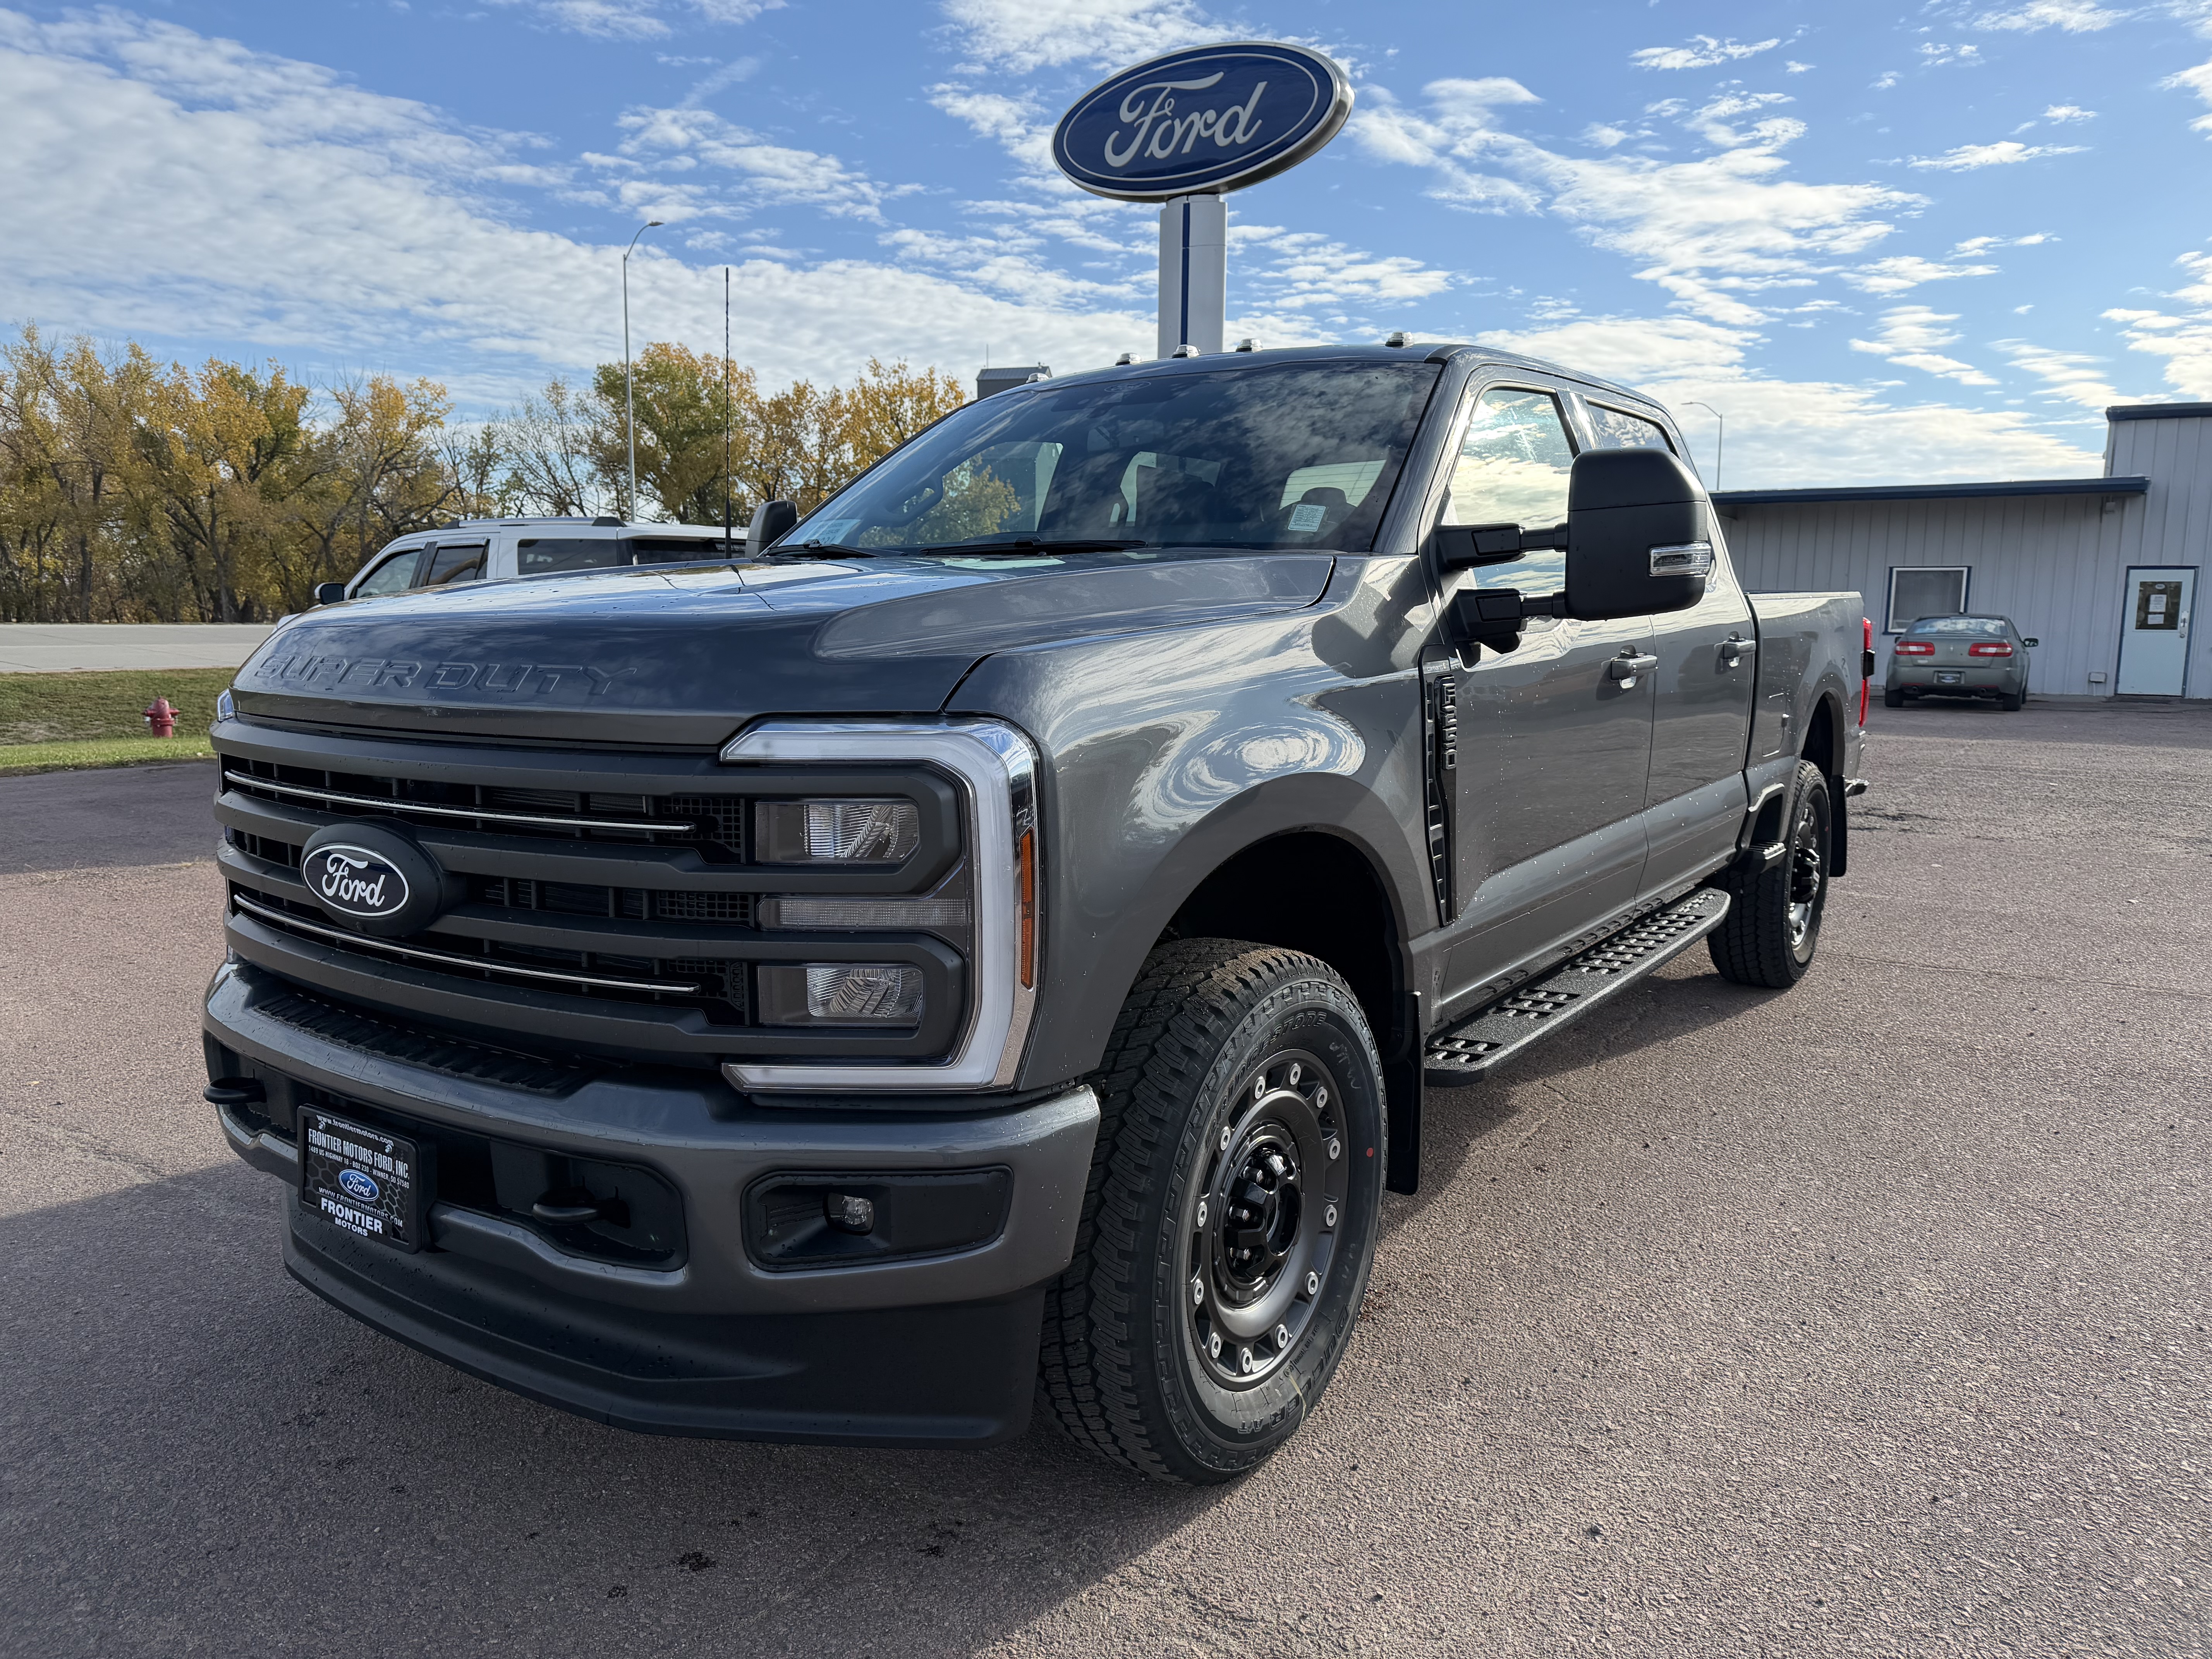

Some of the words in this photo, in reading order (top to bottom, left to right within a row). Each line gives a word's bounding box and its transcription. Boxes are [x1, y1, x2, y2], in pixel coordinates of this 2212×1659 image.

[1104, 71, 1268, 167] Ford
[254, 654, 423, 689] SUPER
[423, 661, 638, 696] DUTY
[322, 853, 385, 907] Ford
[316, 1114, 394, 1146] www.frontiermotors.com
[308, 1128, 342, 1154] FRONTIER
[343, 1140, 373, 1165] MOTORS
[374, 1151, 395, 1175] FORD,
[325, 1151, 343, 1163] HIGHWAY
[352, 1161, 361, 1170] BOX
[361, 1164, 369, 1173] 230
[397, 1178, 409, 1189] 57580
[347, 1174, 371, 1197] Ford
[321, 1197, 383, 1234] FRONTIER
[335, 1217, 368, 1237] MOTORS
